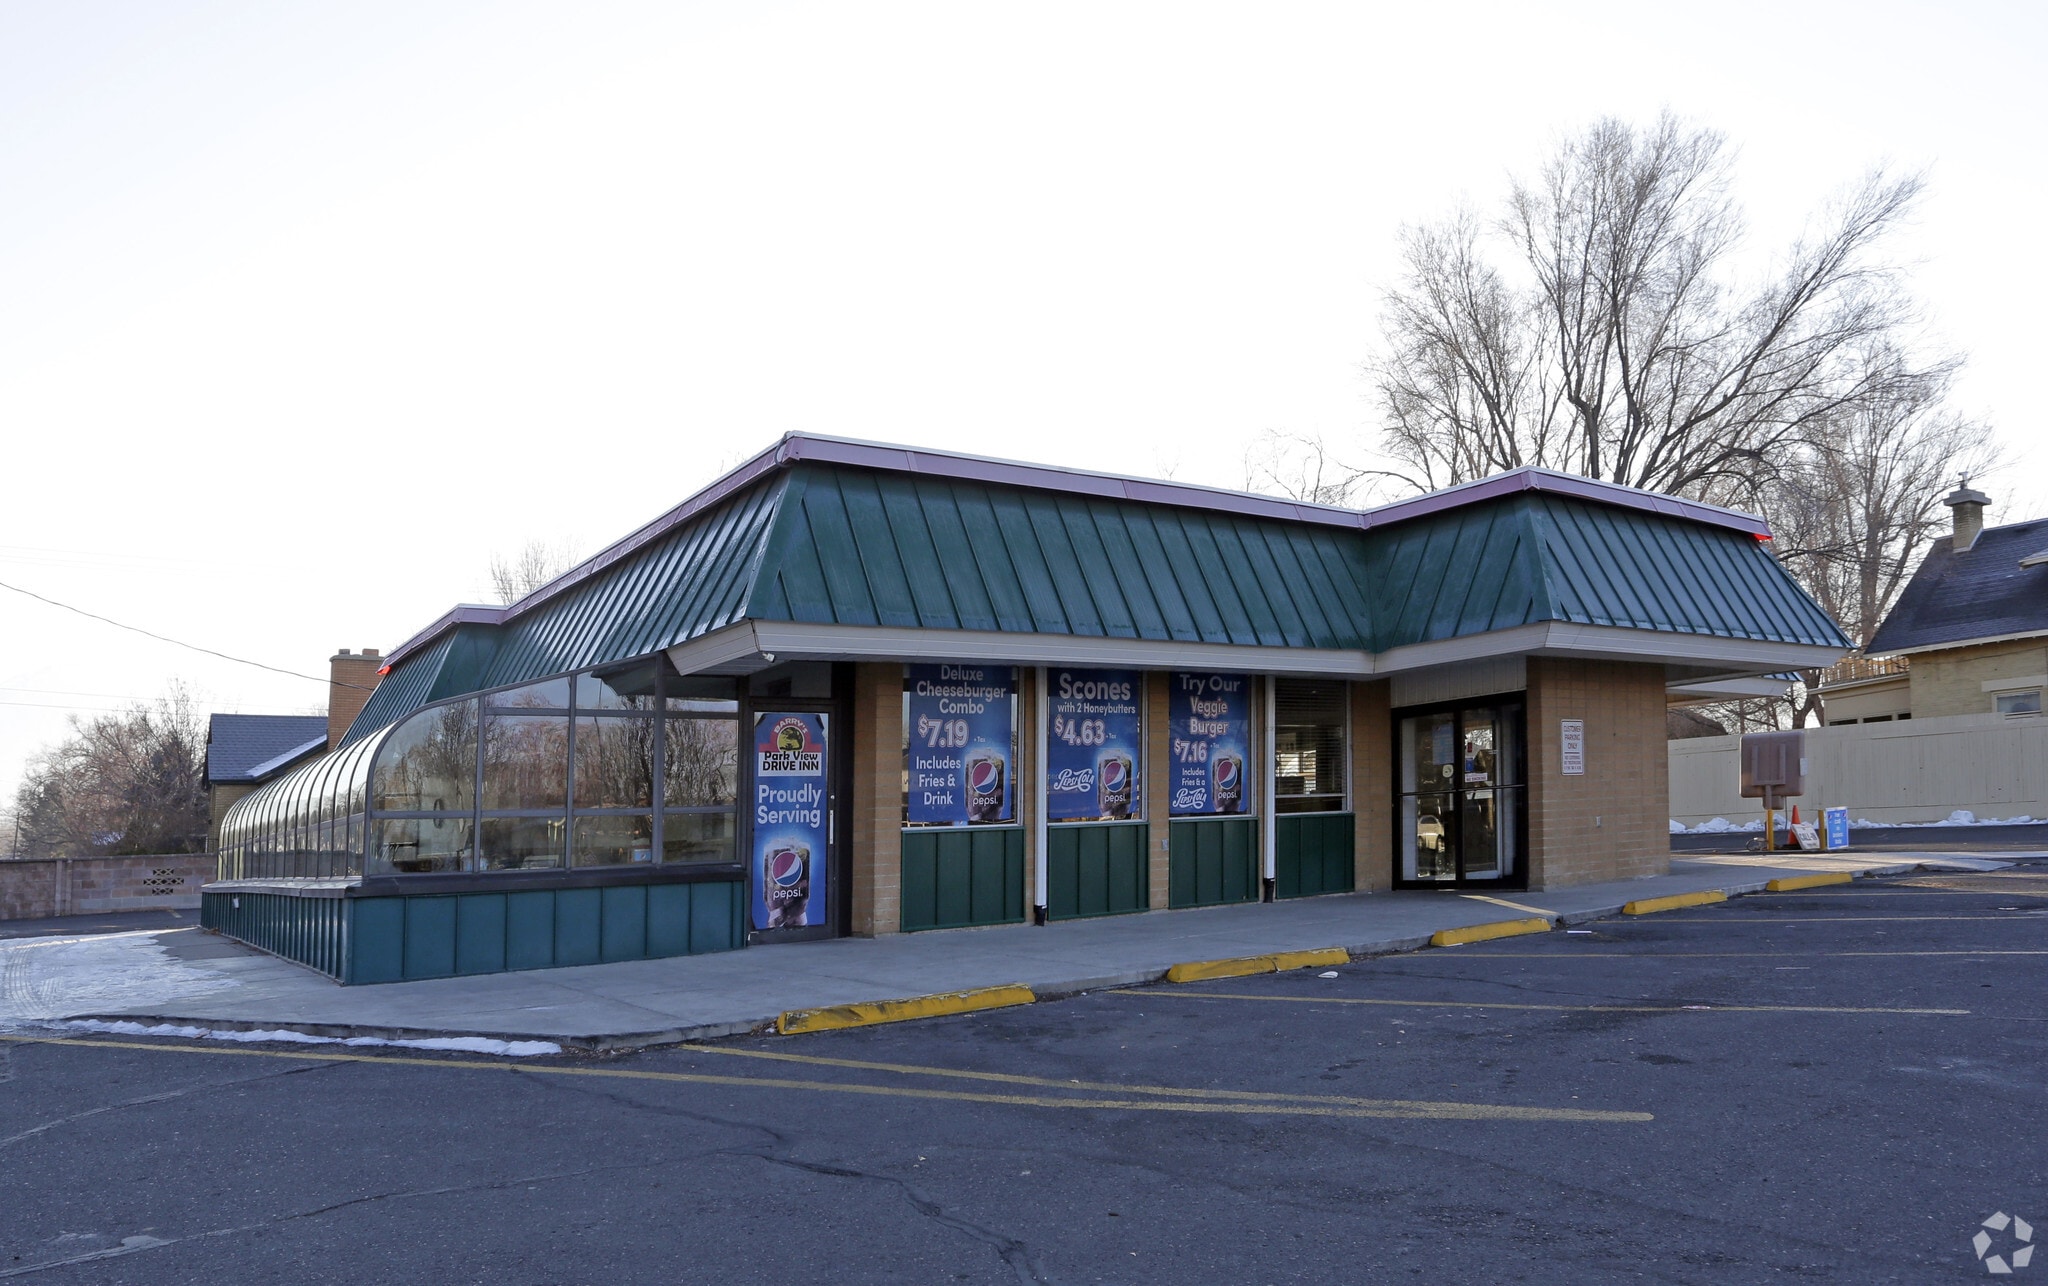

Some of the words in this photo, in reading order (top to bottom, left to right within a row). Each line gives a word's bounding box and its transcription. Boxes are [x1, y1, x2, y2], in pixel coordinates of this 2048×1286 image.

[941, 664, 984, 680] Deluxe
[916, 681, 1006, 702] Cheeseburger
[1059, 673, 1131, 701] Scones
[1179, 674, 1205, 695] Try
[1209, 675, 1240, 692] Our
[939, 698, 984, 714] Combo
[1057, 701, 1075, 713] with
[1077, 702, 1082, 713] 2
[1083, 702, 1136, 717] Honeybutters
[1189, 697, 1228, 717] Veggie
[918, 714, 969, 748] $7.19
[1054, 714, 1106, 746] $4.63
[1189, 718, 1229, 738] Burger
[764, 751, 790, 761] Park
[793, 751, 818, 761] View
[1174, 738, 1207, 763] $7.16
[763, 761, 796, 771] DRIVE
[799, 761, 819, 771] INN
[916, 756, 961, 770] Includes
[1182, 767, 1205, 776] Includes
[919, 774, 945, 788] Fries
[947, 774, 956, 788] &
[1181, 778, 1195, 786] Fries
[759, 783, 822, 808] Proudly
[924, 792, 954, 806] Drink
[972, 795, 997, 807] pepsi
[1104, 793, 1126, 804] pepsi
[757, 805, 821, 828] Serving
[773, 887, 802, 901] pepsi
